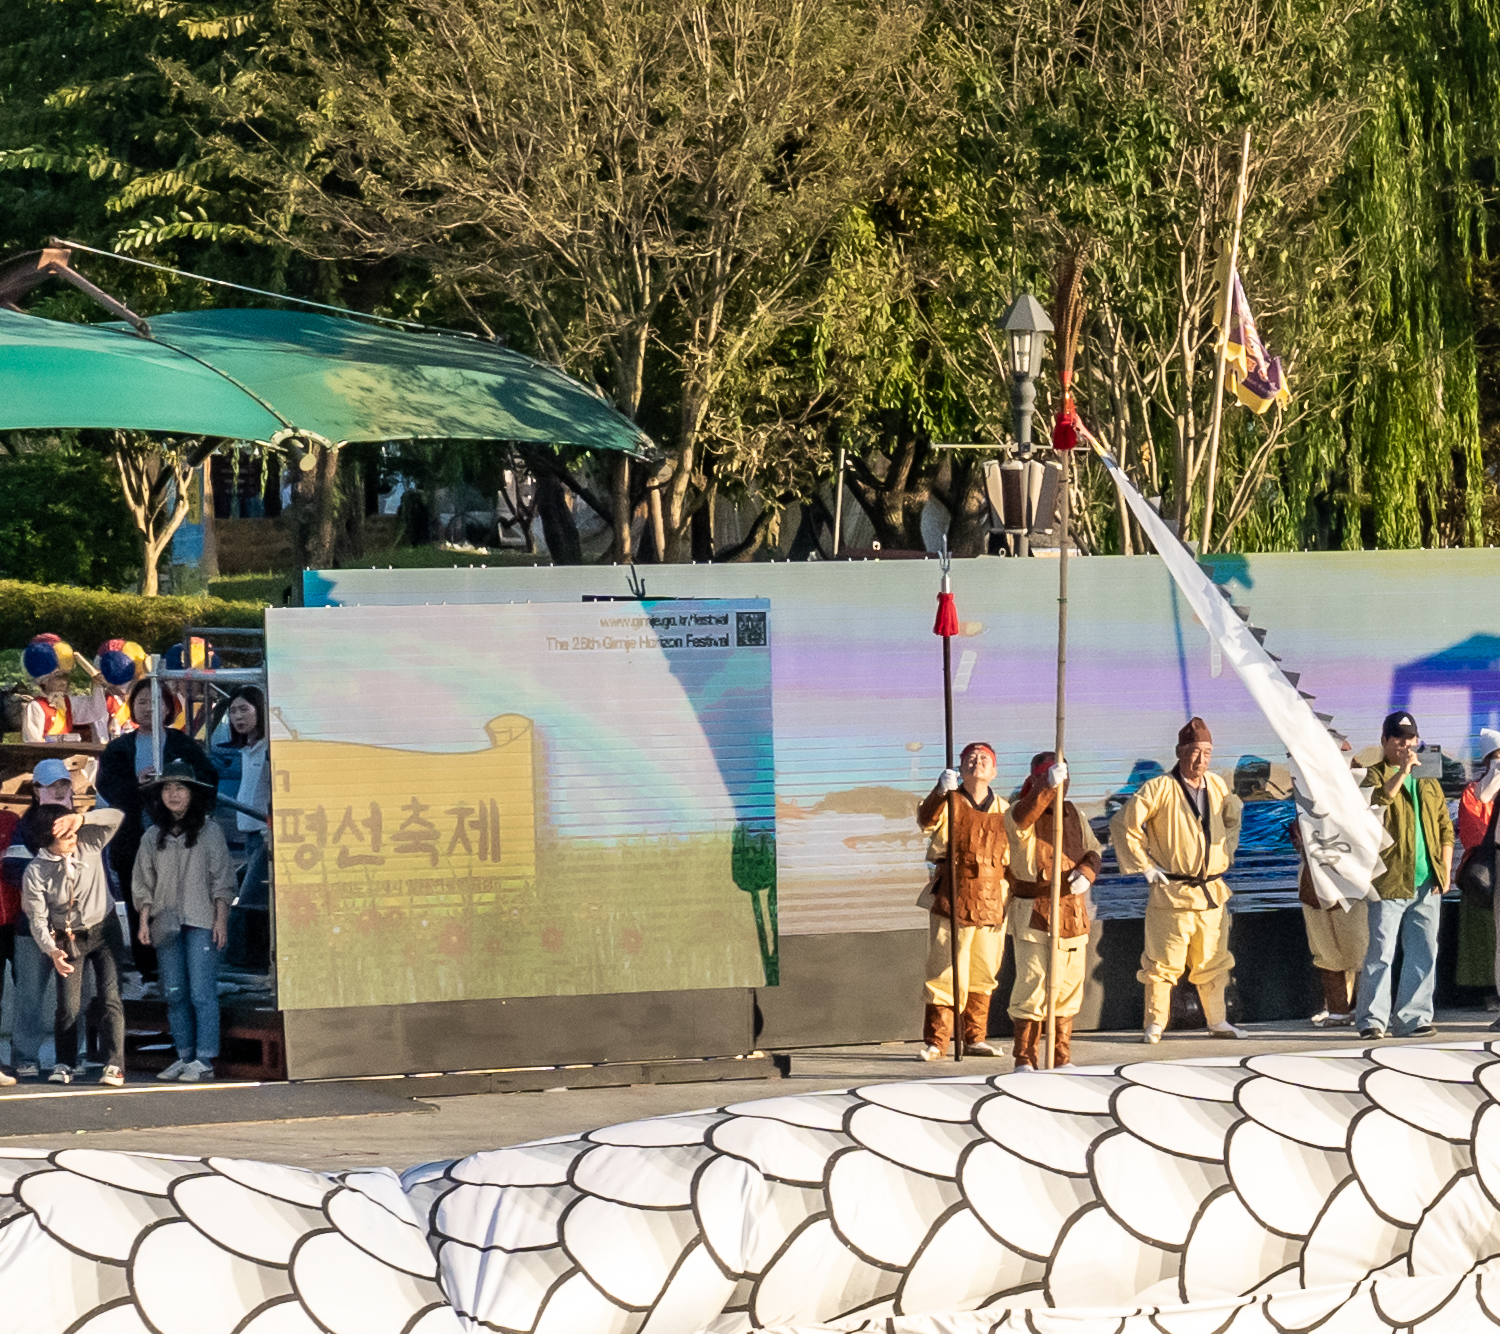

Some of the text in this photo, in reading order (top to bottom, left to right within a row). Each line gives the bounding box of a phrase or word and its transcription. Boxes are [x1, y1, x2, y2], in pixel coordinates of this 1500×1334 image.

[546, 637, 569, 651] The
[602, 635, 637, 652] Gimje
[639, 634, 683, 650] Horizon
[686, 633, 730, 648] Festival
[274, 796, 501, 872] 평선축제
